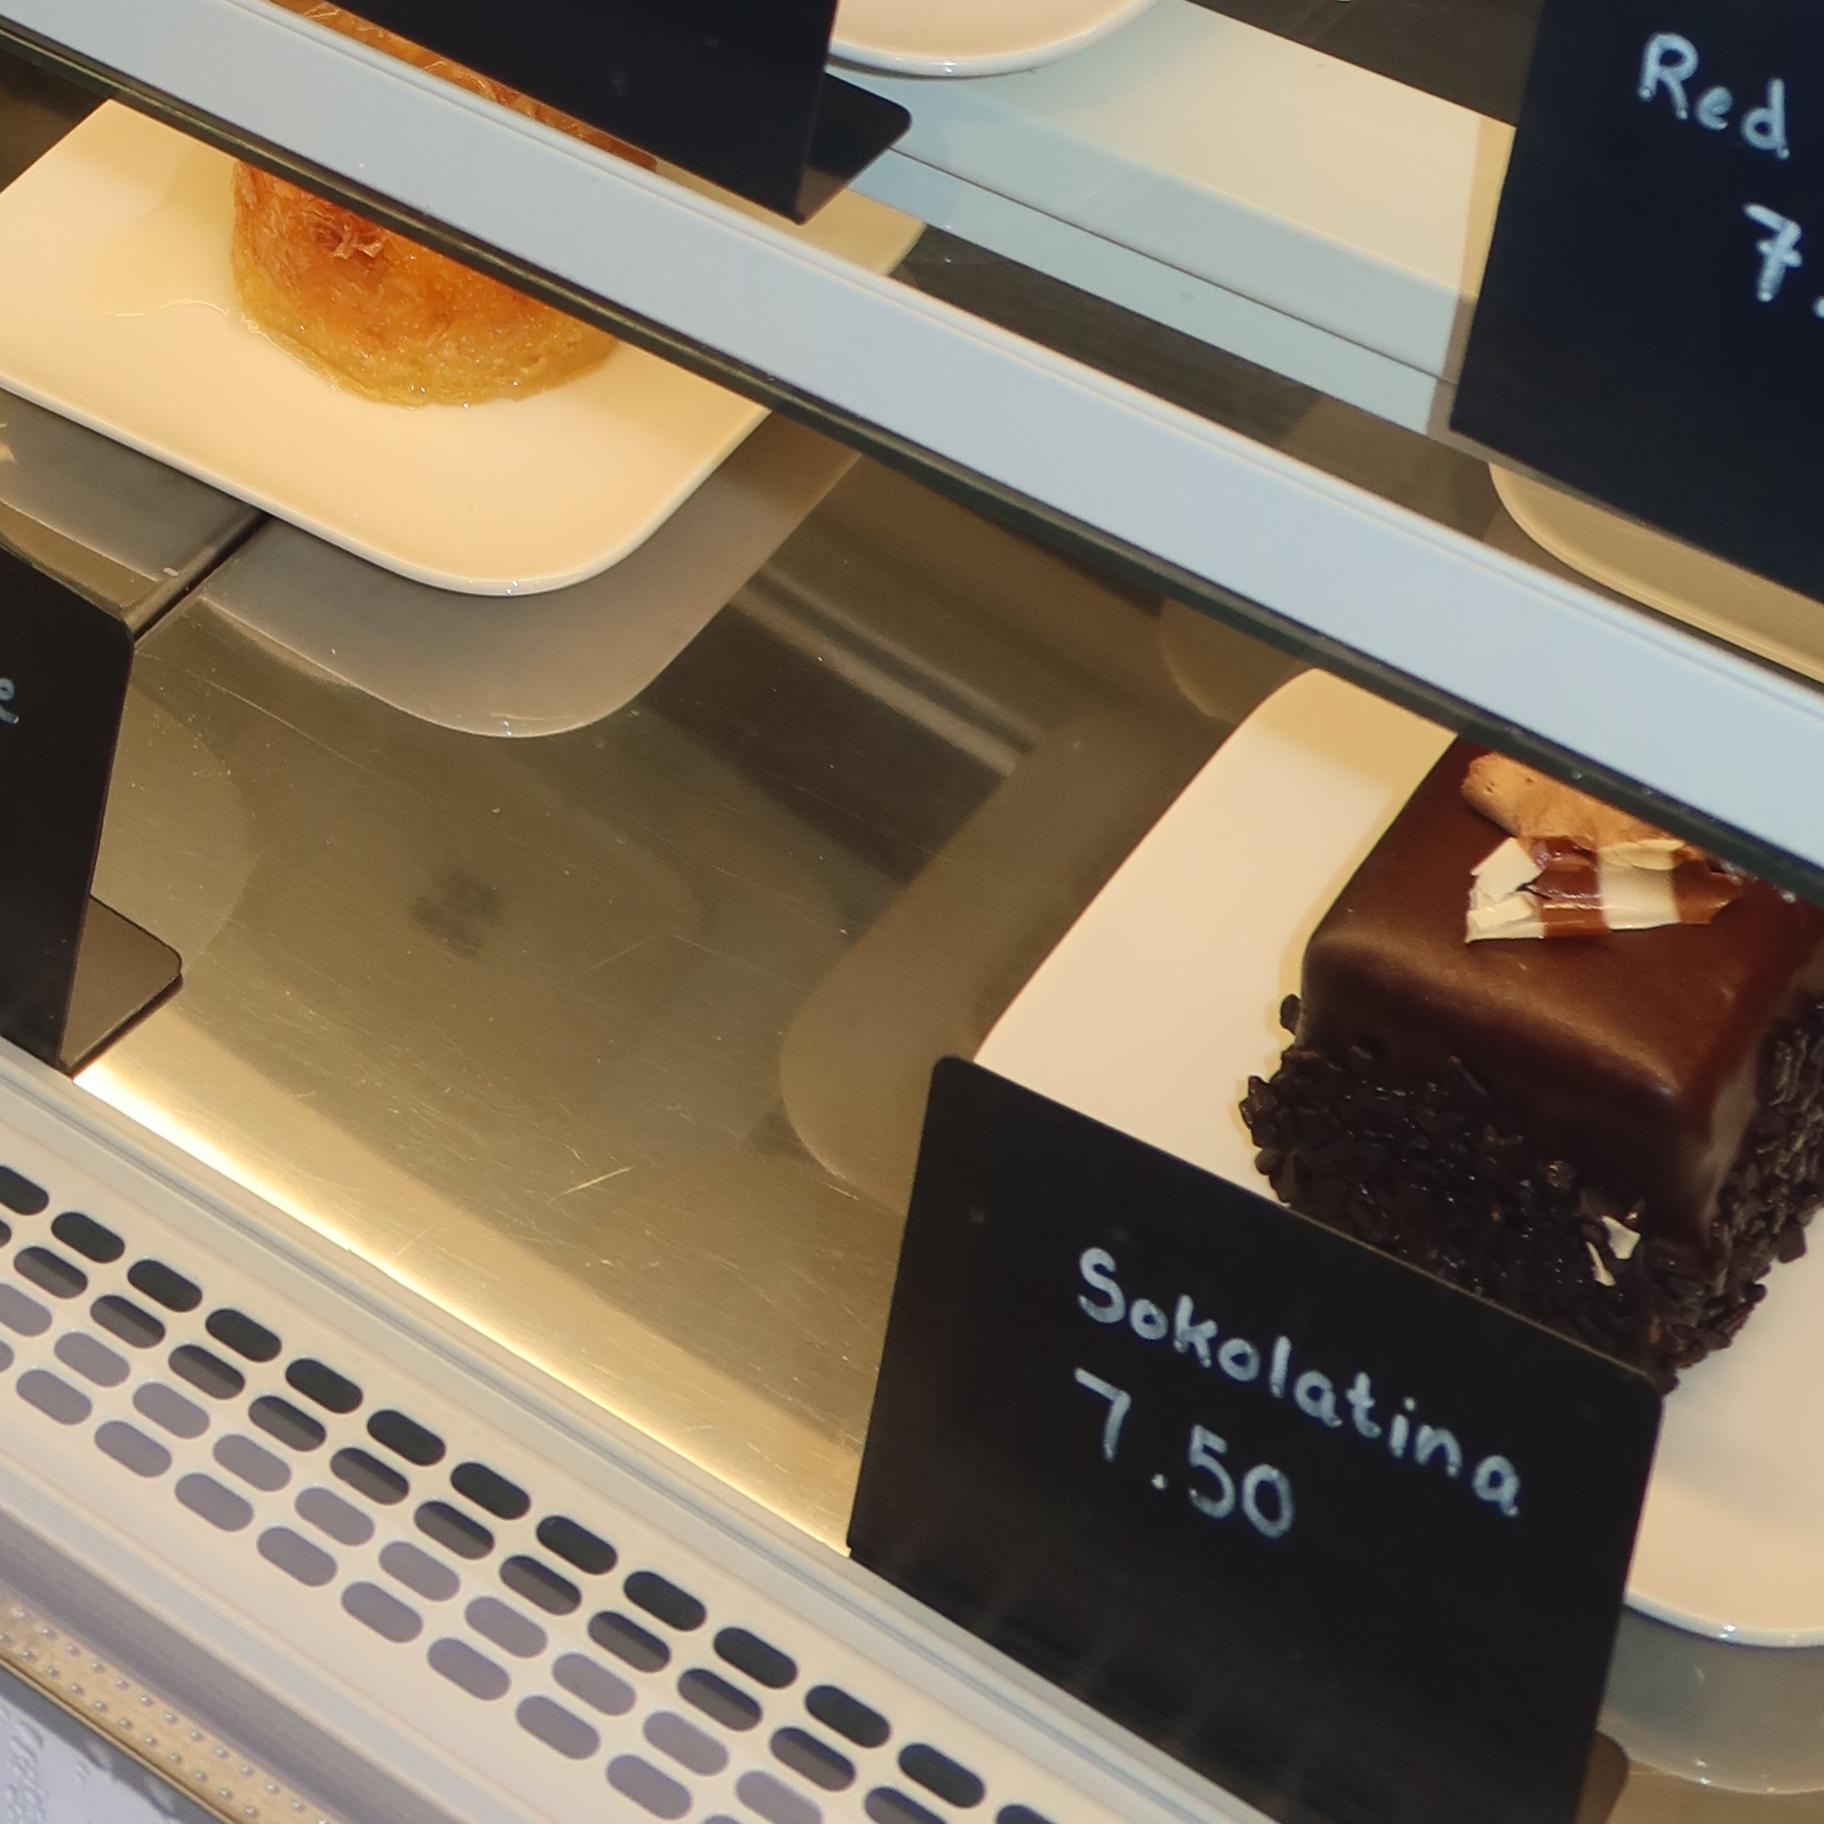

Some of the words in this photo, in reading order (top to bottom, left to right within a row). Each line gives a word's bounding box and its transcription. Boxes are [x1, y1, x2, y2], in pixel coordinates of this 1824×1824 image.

[1639, 33, 1789, 158] Red
[1077, 1368, 1294, 1538] 7.50
[1079, 1248, 1520, 1517] Sokolatina
